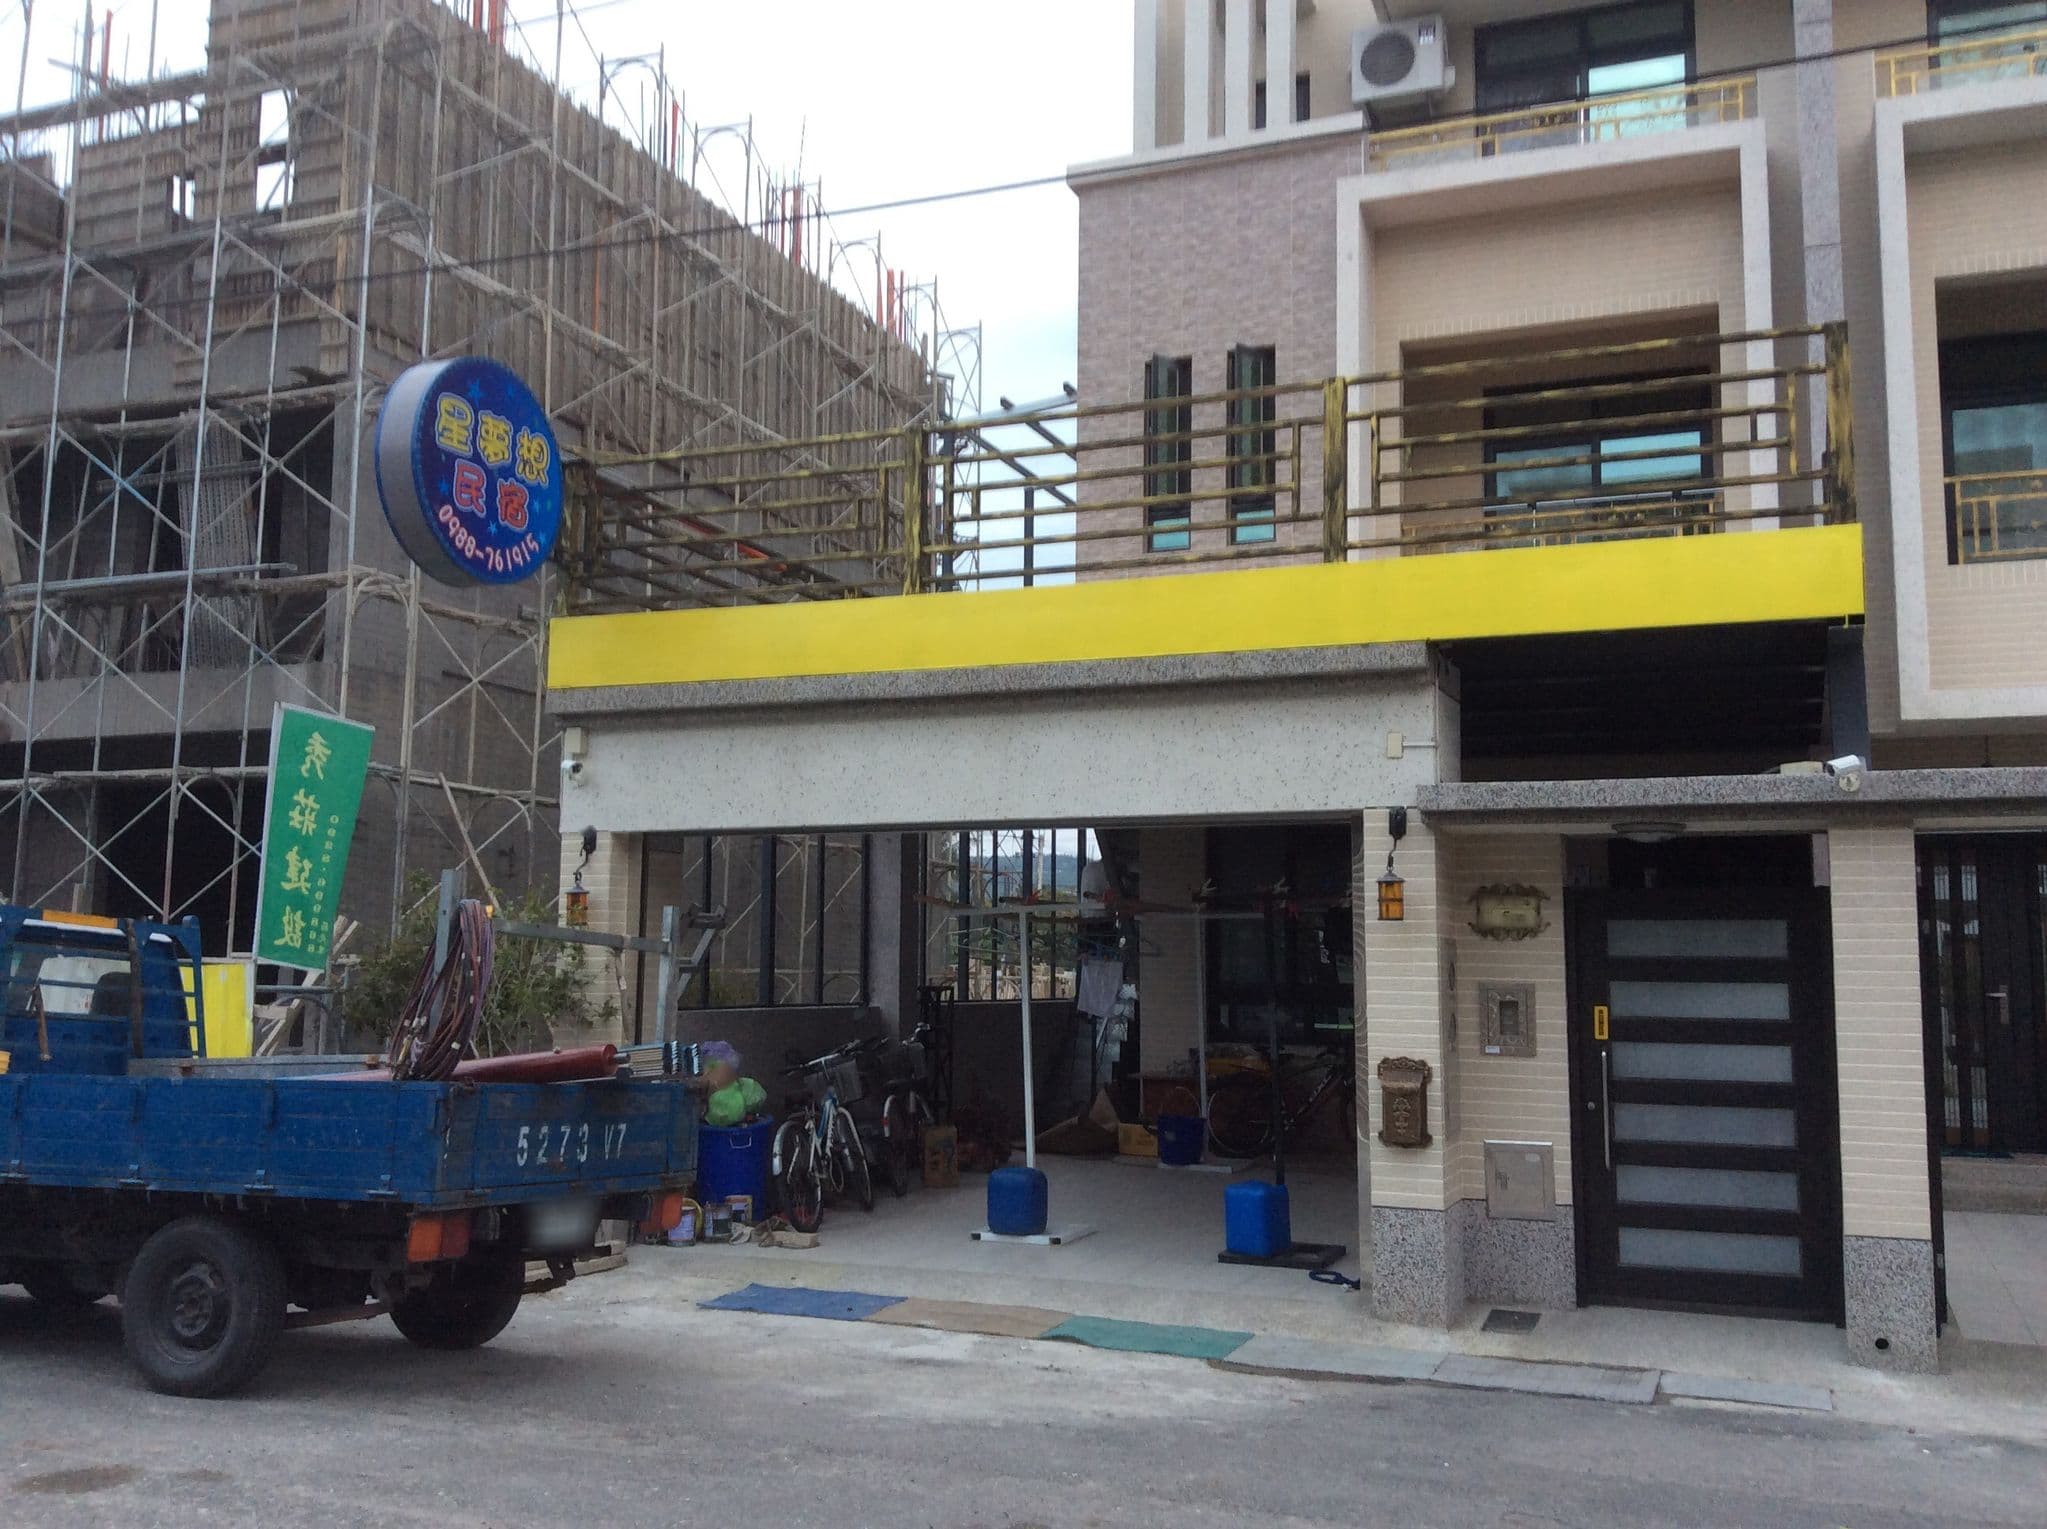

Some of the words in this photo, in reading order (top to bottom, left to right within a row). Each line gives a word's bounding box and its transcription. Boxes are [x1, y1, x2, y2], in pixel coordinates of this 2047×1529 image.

[454, 459, 529, 529] 民宿
[439, 504, 540, 573] 0988-761915
[517, 1123, 589, 1166] 5273
